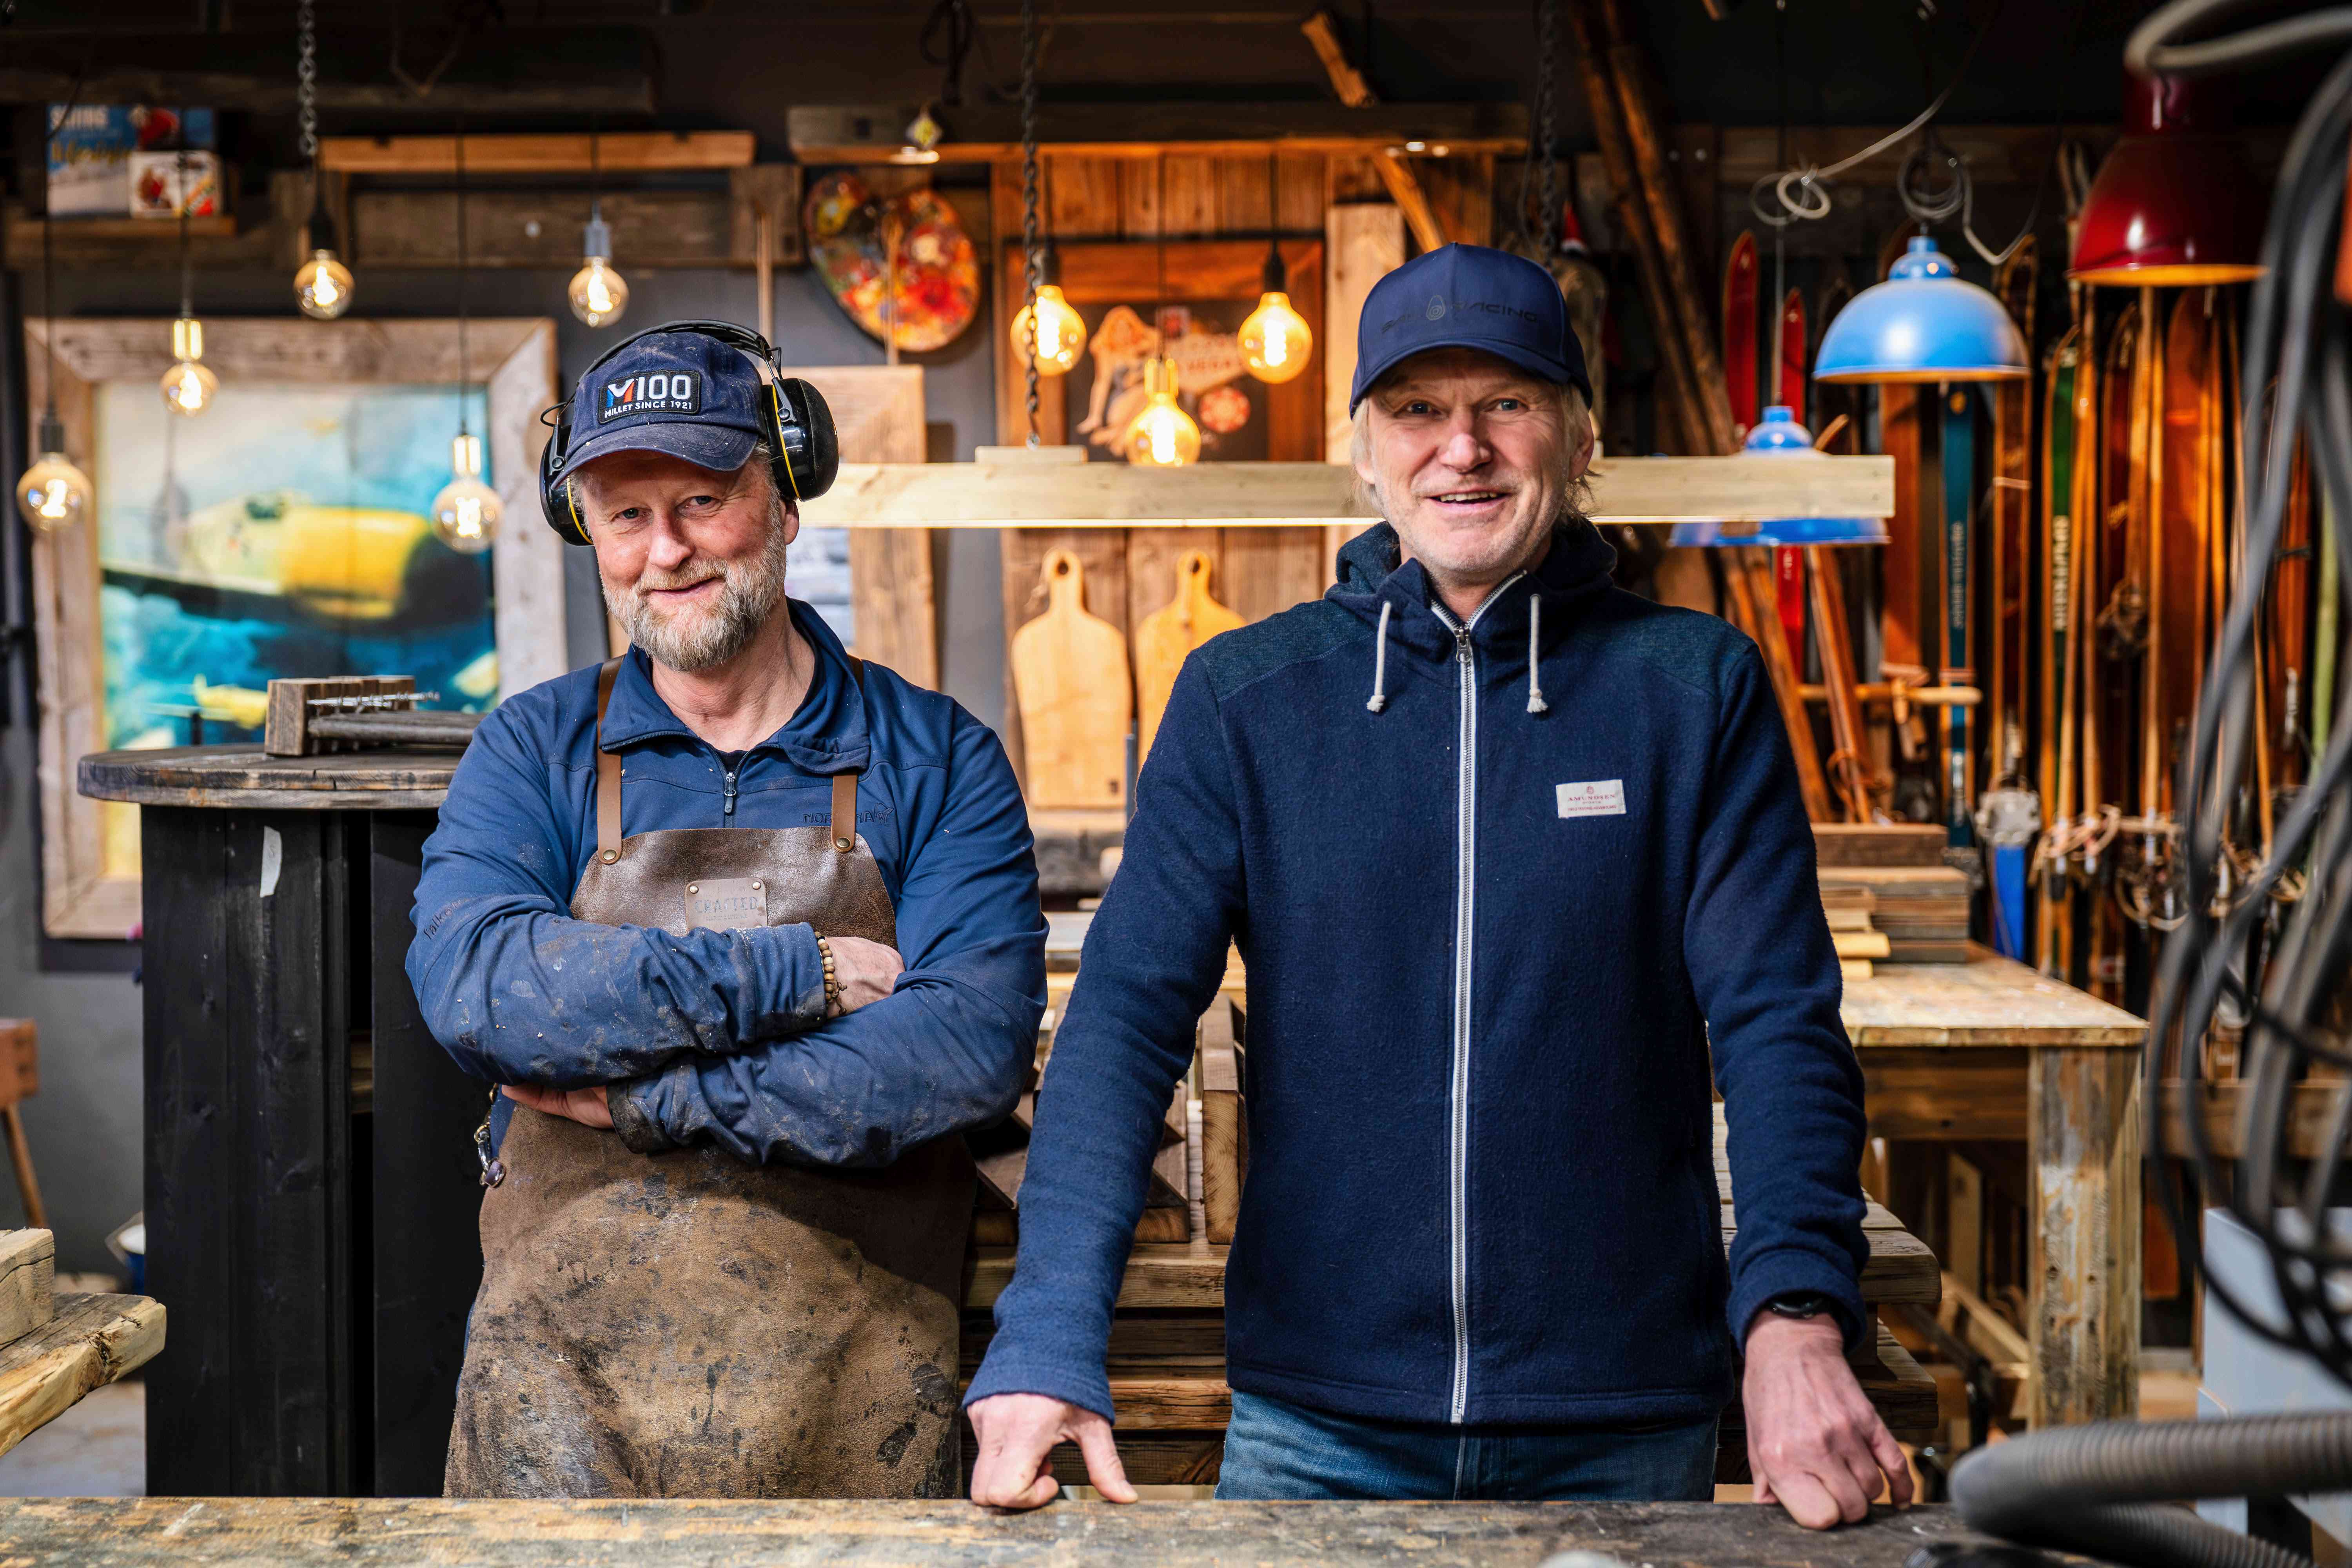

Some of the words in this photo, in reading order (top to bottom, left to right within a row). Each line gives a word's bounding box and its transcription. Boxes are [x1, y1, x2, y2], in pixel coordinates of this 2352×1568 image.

[1451, 301, 1537, 323] RACING
[604, 404, 633, 418] MILLET
[635, 401, 666, 410] SINCE
[671, 400, 691, 410] 1921
